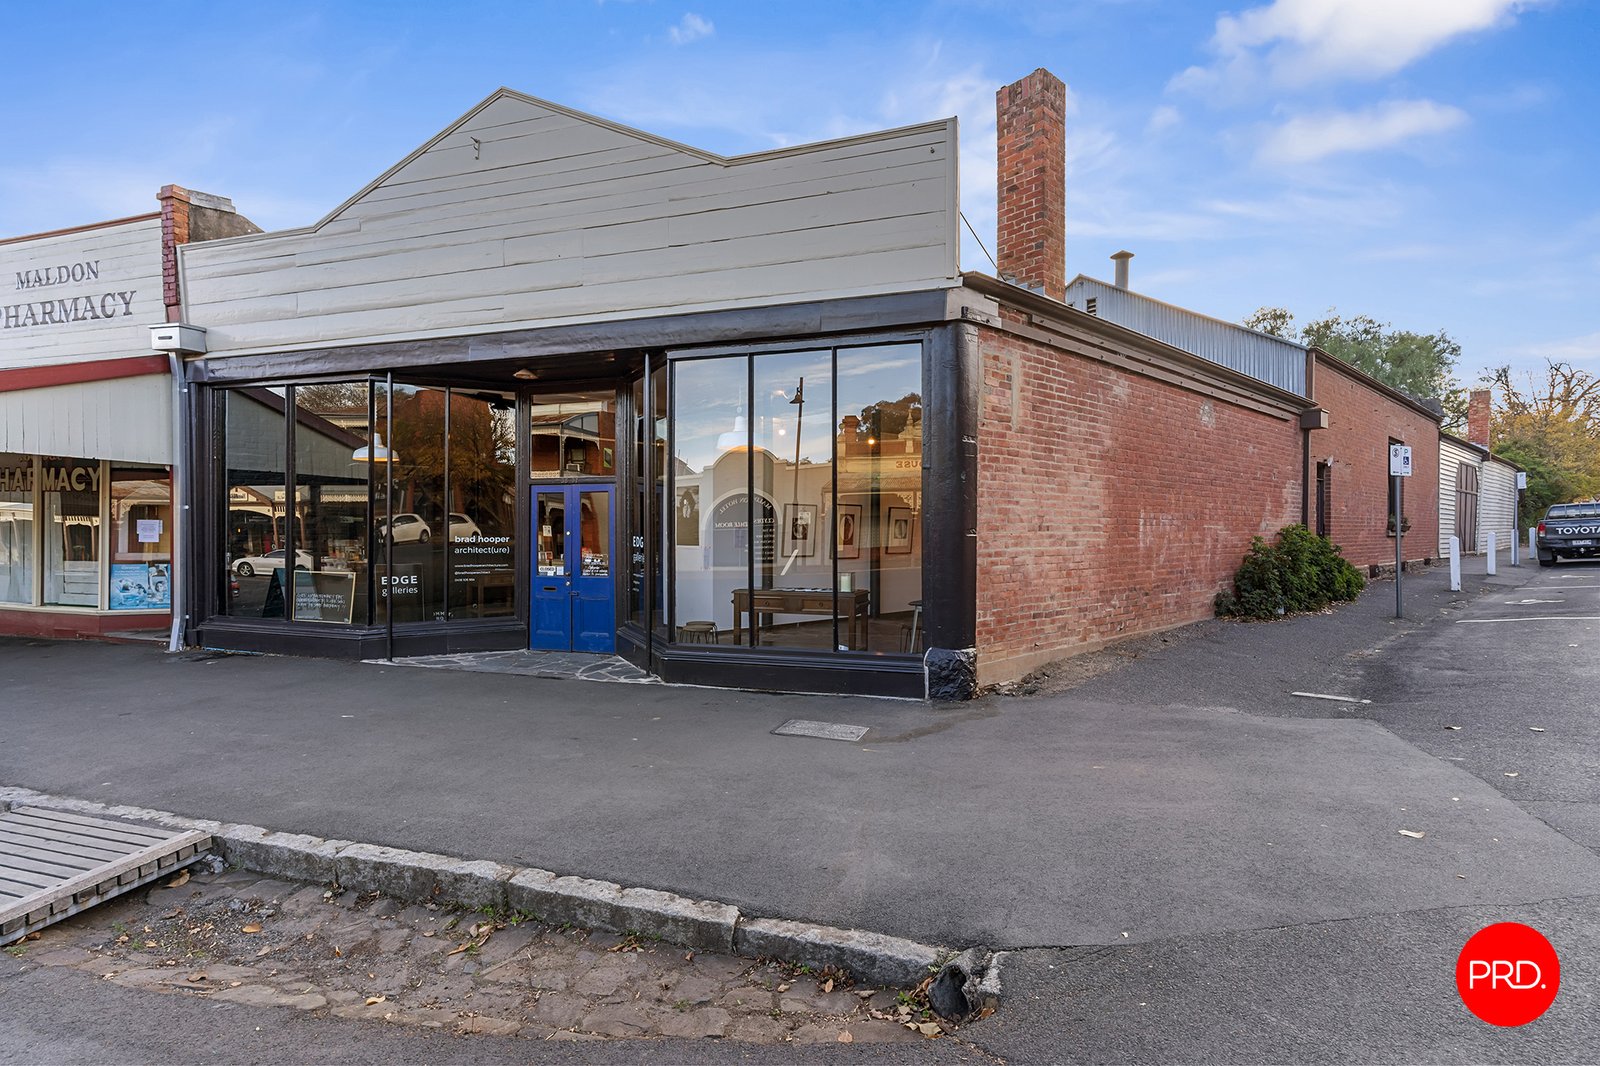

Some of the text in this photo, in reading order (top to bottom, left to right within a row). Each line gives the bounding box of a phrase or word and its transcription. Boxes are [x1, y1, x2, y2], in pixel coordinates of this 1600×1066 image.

[16, 260, 100, 290] MALDON
[0, 290, 137, 329] HARMACY
[454, 535, 510, 544] brad hooper
[454, 546, 510, 554] architect(ure)
[381, 575, 418, 585] EDGE
[381, 586, 418, 597] glleries
